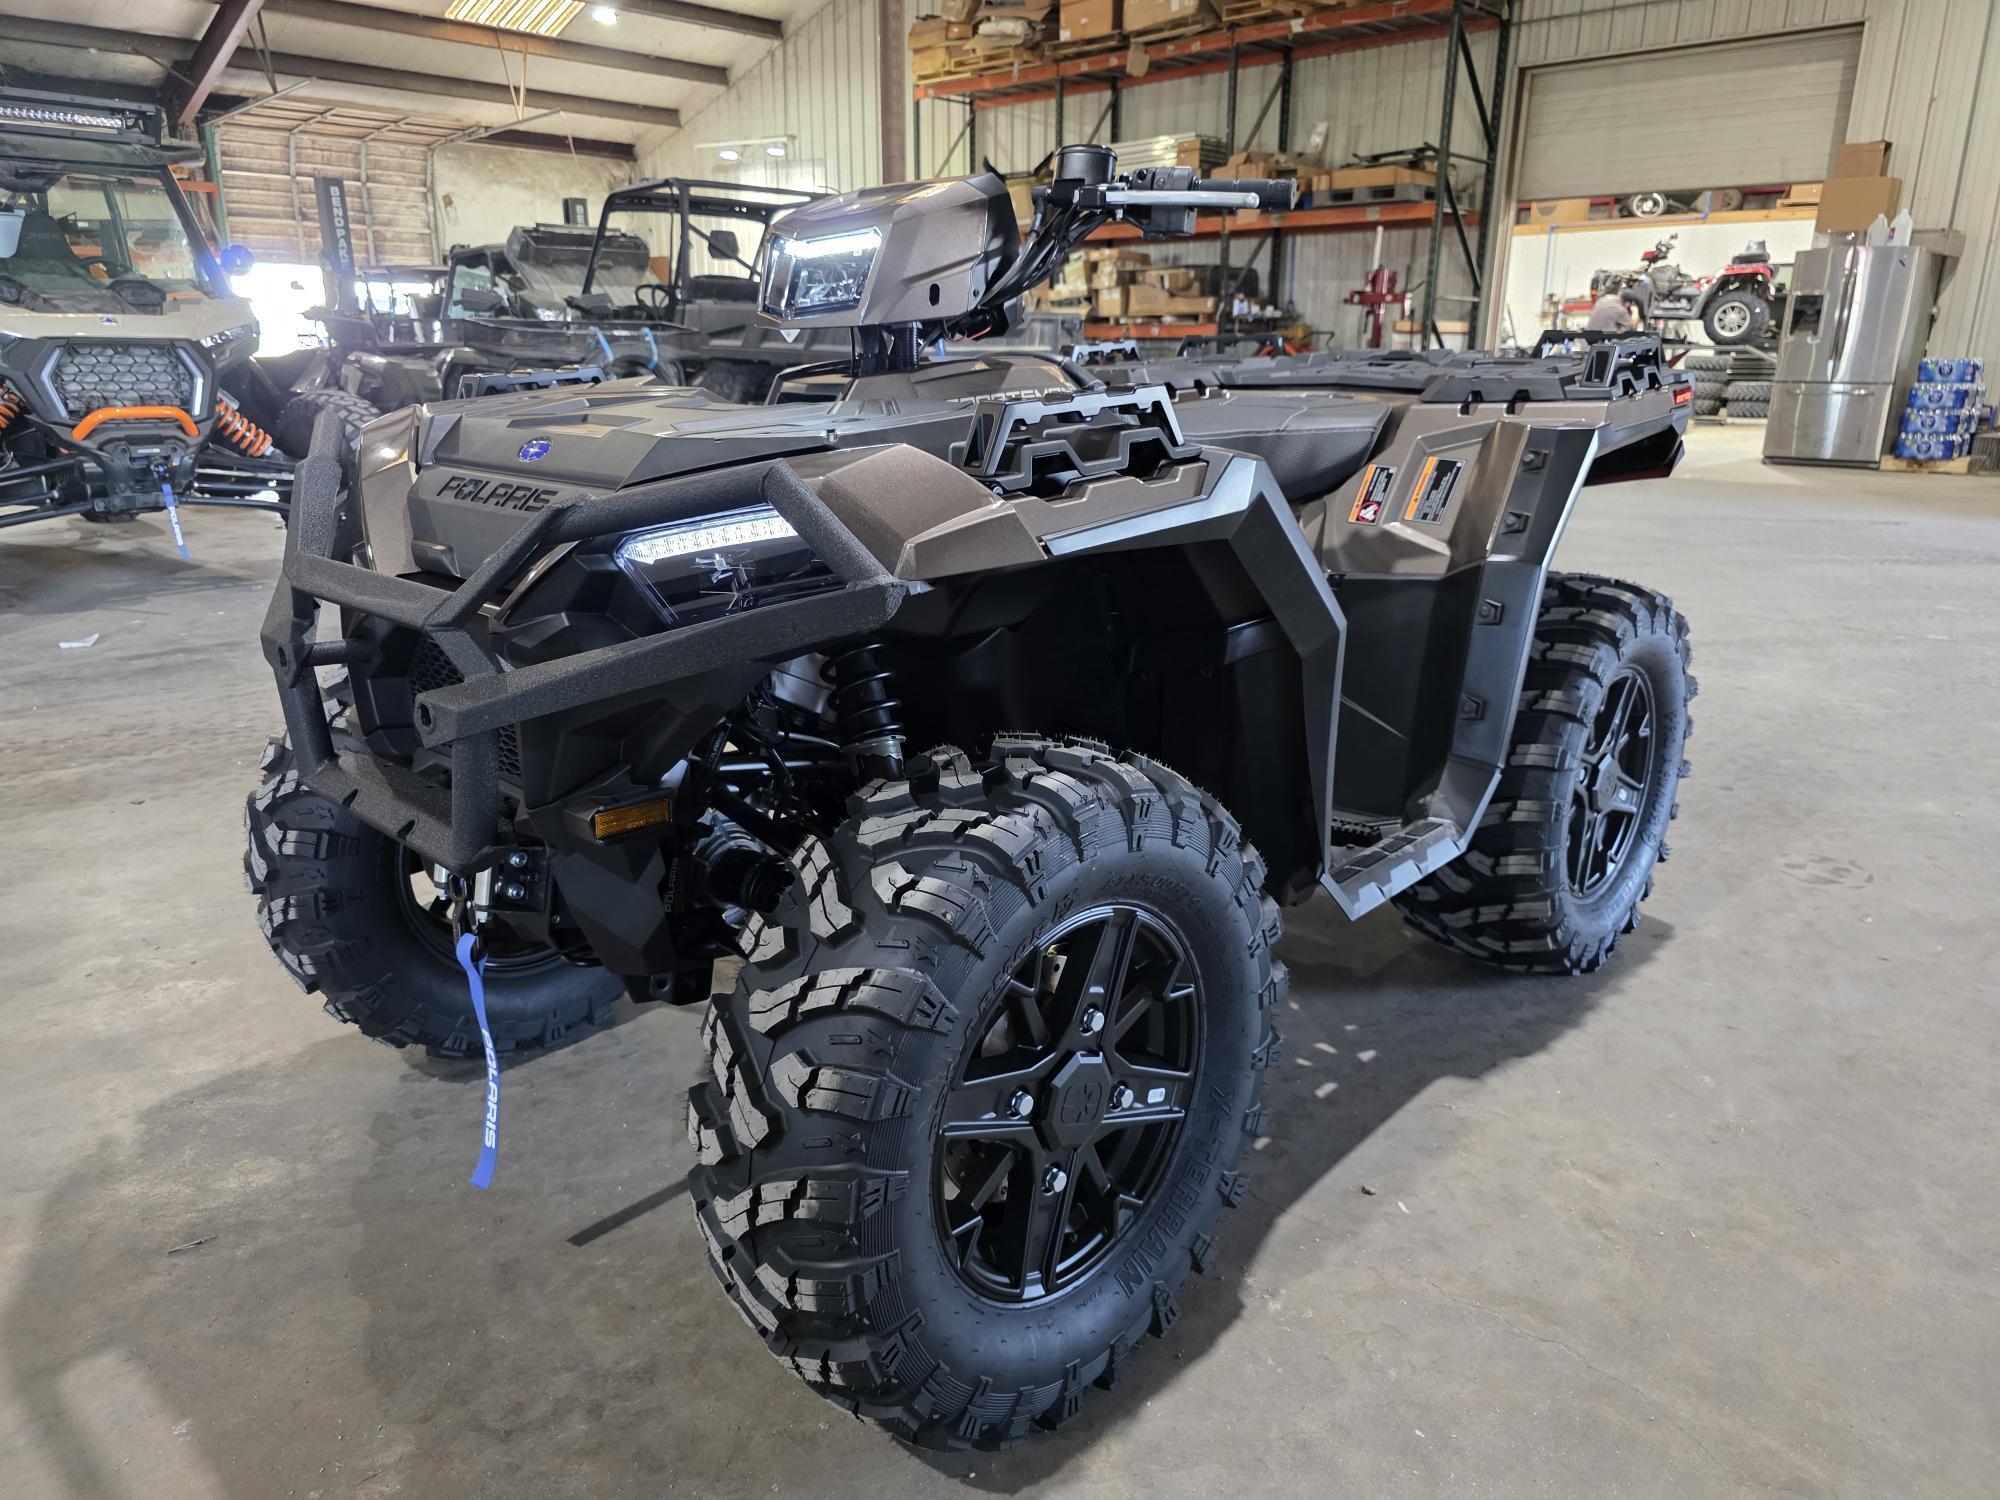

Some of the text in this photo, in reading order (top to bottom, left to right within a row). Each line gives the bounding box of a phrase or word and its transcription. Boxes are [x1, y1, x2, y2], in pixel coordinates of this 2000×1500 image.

[330, 186, 349, 263] BENDPAK
[436, 476, 559, 512] POLARIS
[481, 1028, 498, 1149] POLARIS
[1113, 1086, 1234, 1299] X-TERRAIN
